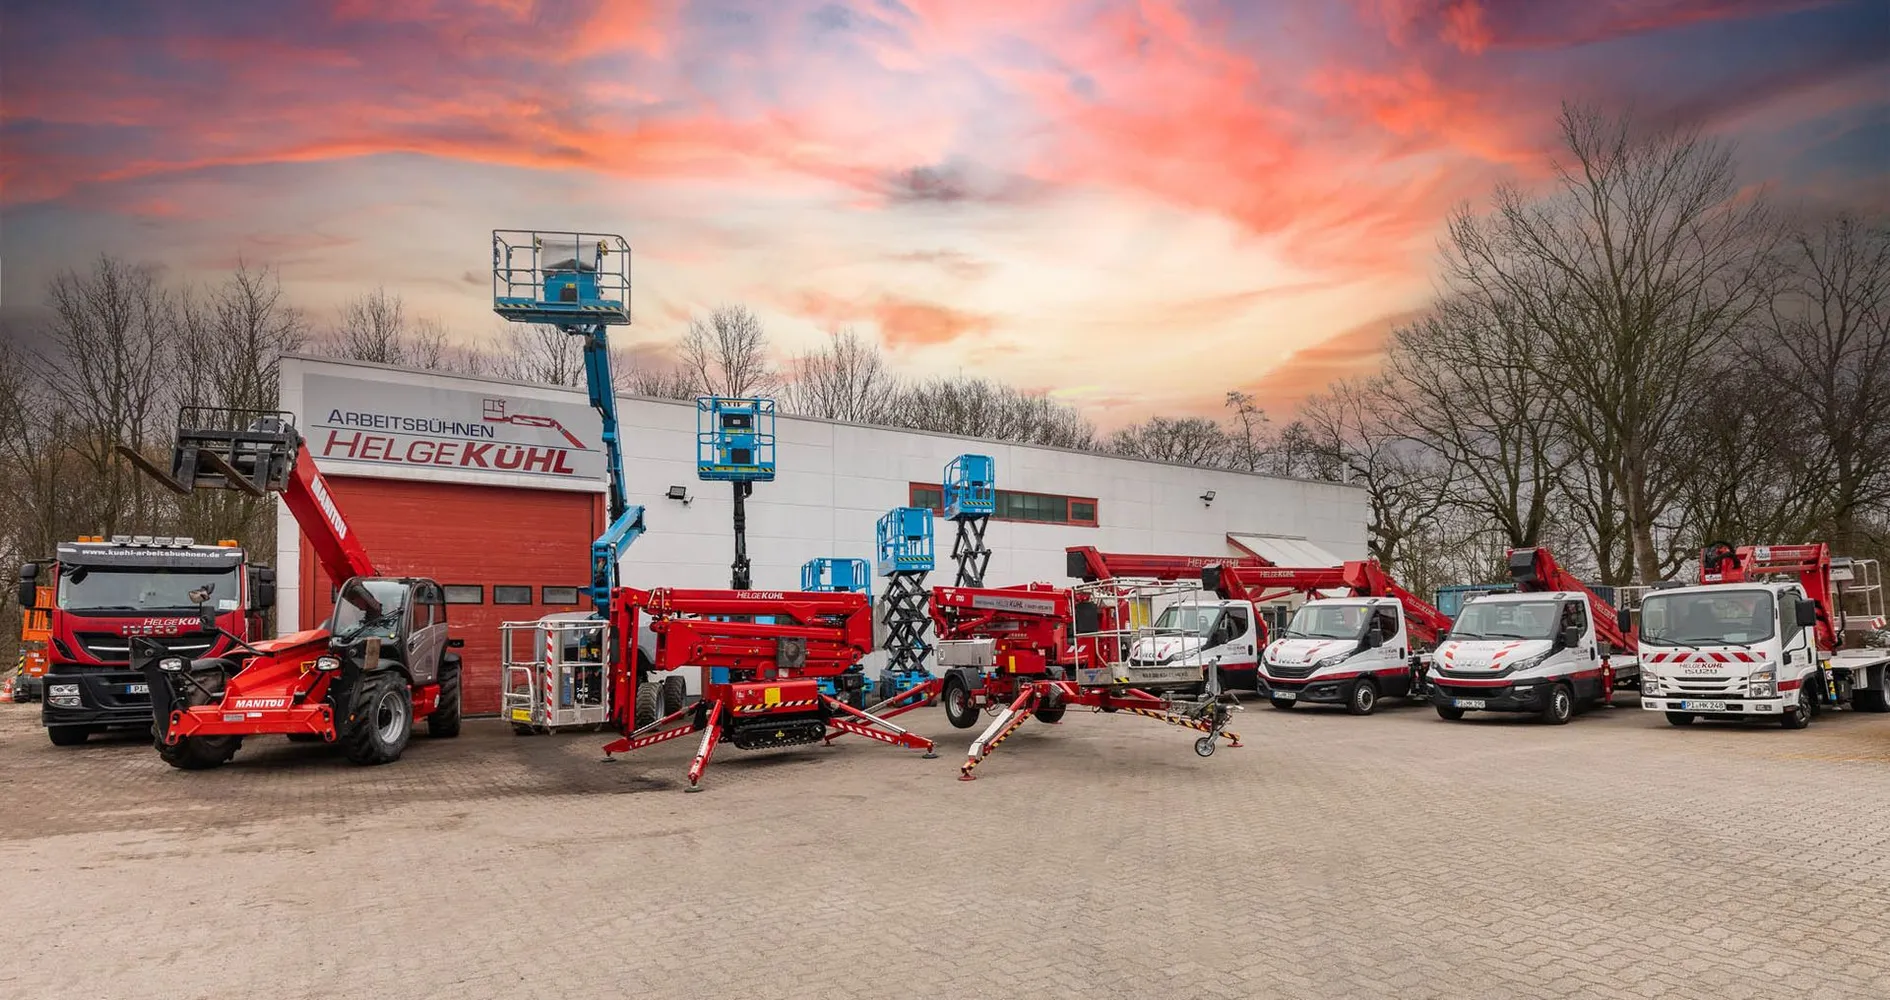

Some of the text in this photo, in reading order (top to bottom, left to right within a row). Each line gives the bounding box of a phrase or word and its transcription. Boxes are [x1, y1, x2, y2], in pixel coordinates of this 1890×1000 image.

[327, 408, 494, 439] ARBEITSBÜHNEN
[311, 473, 348, 540] MANITOU
[82, 549, 220, 559] www.kuehl-arbeitsbuehnen.de
[122, 625, 178, 634] IVECO
[235, 699, 285, 708] MANITOU
